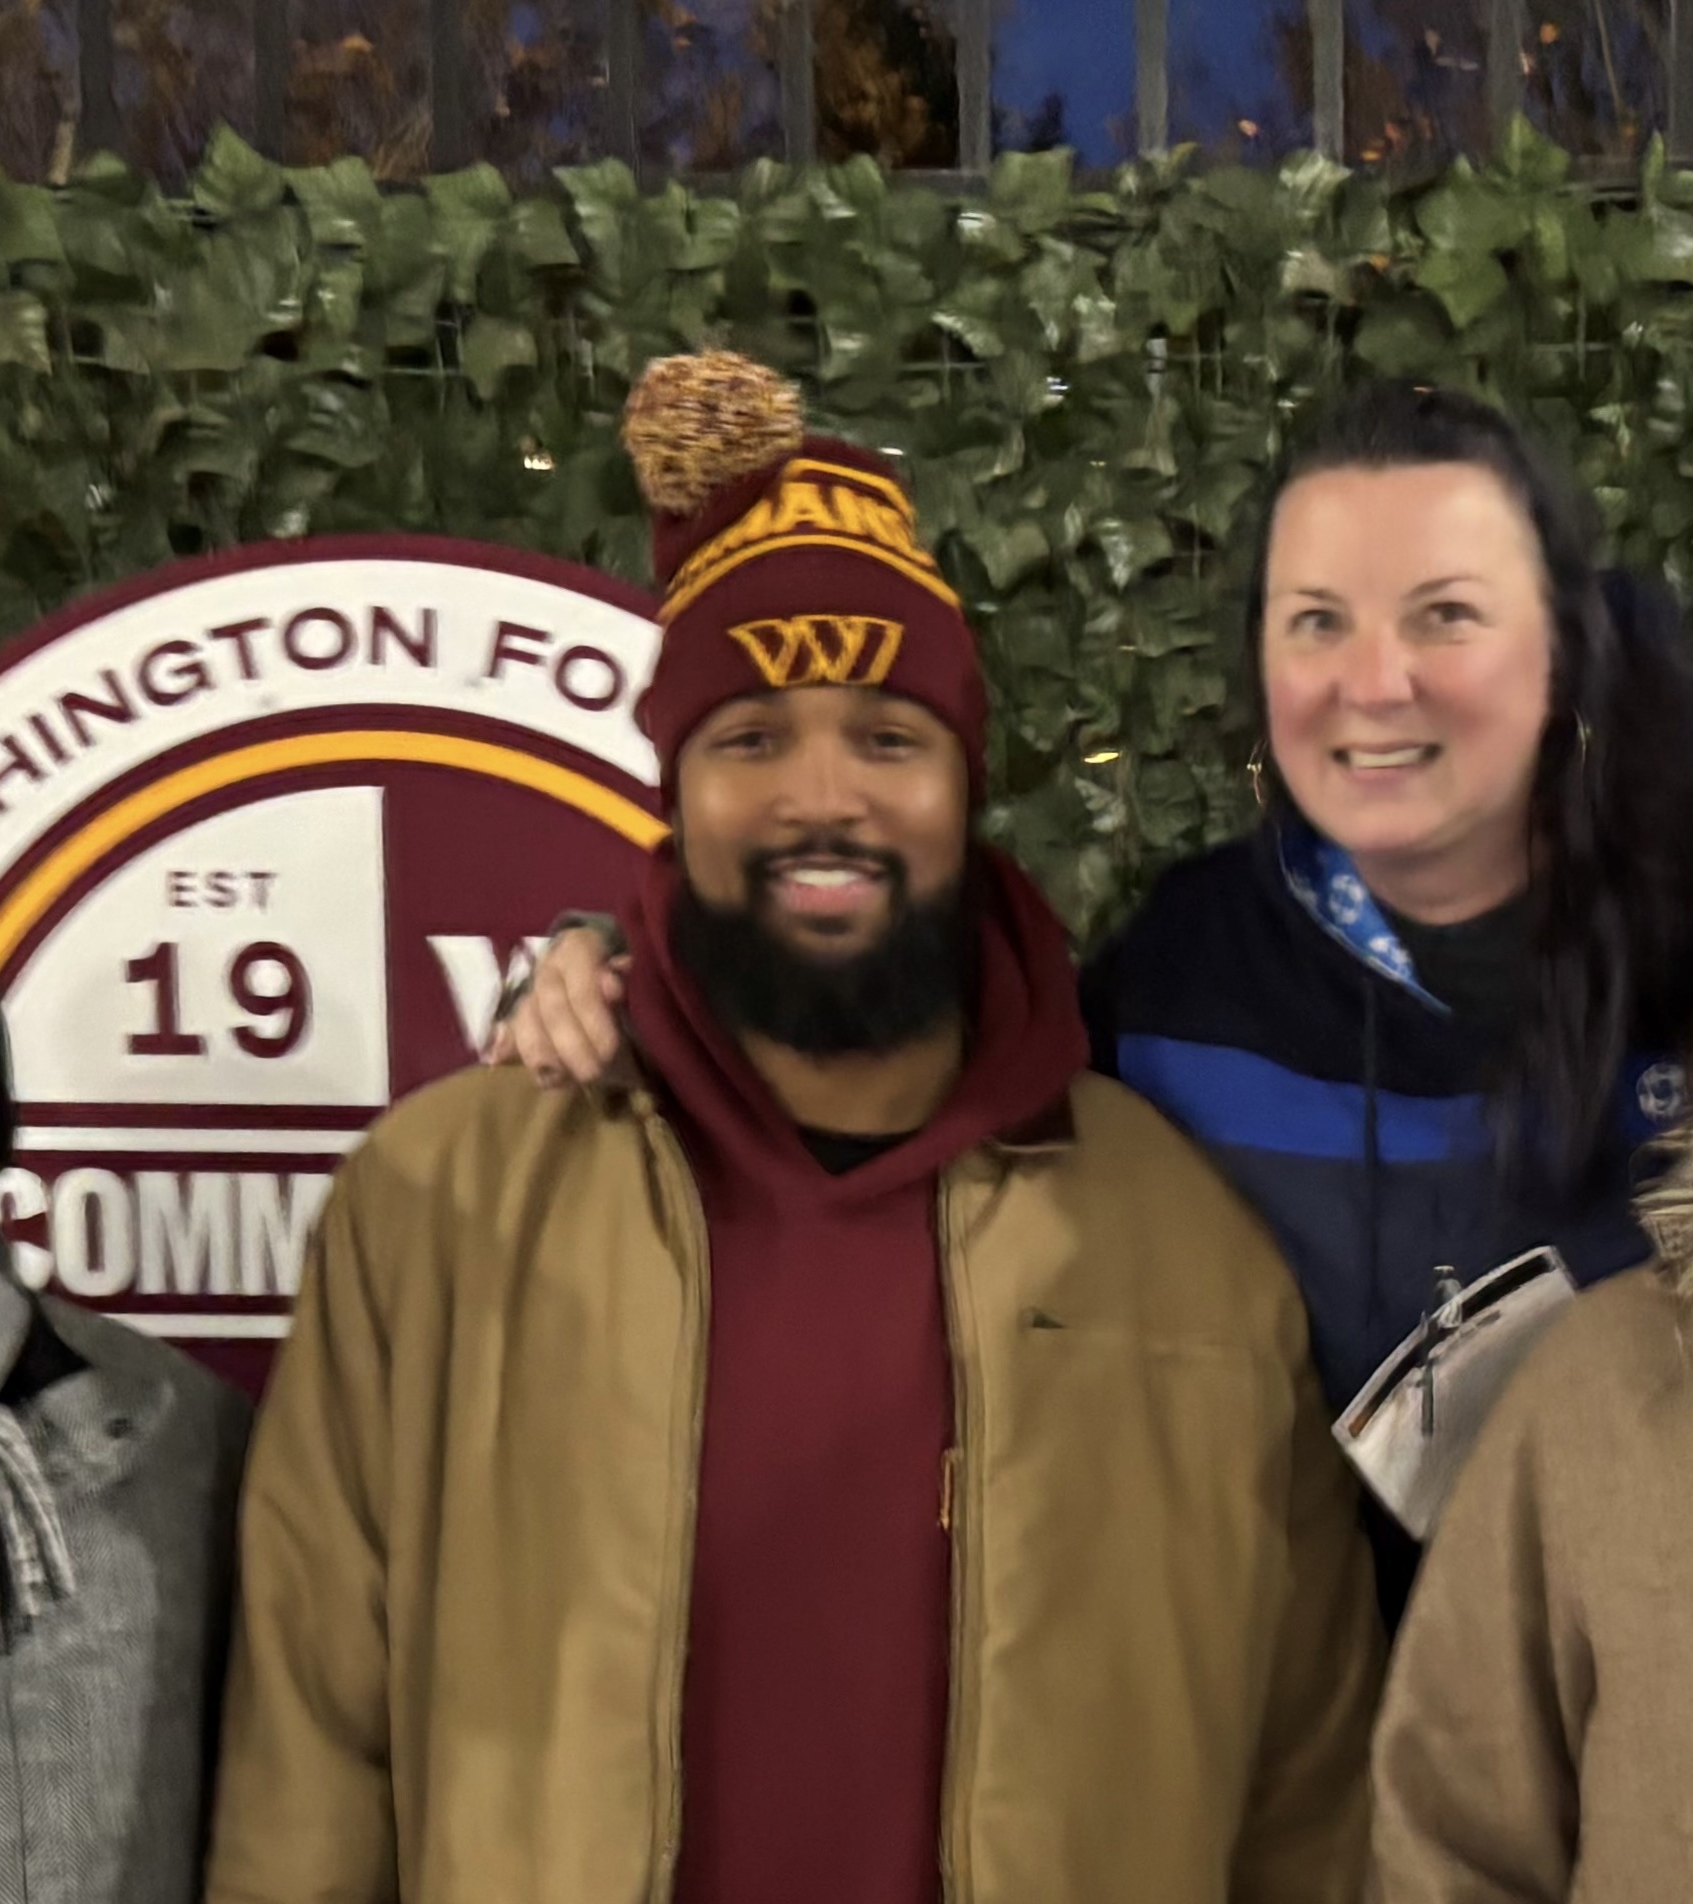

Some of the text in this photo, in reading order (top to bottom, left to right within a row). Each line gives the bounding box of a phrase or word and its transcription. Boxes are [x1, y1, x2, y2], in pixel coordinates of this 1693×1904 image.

[484, 620, 652, 742] FO
[166, 870, 278, 909] EST
[122, 940, 313, 1058] 19
